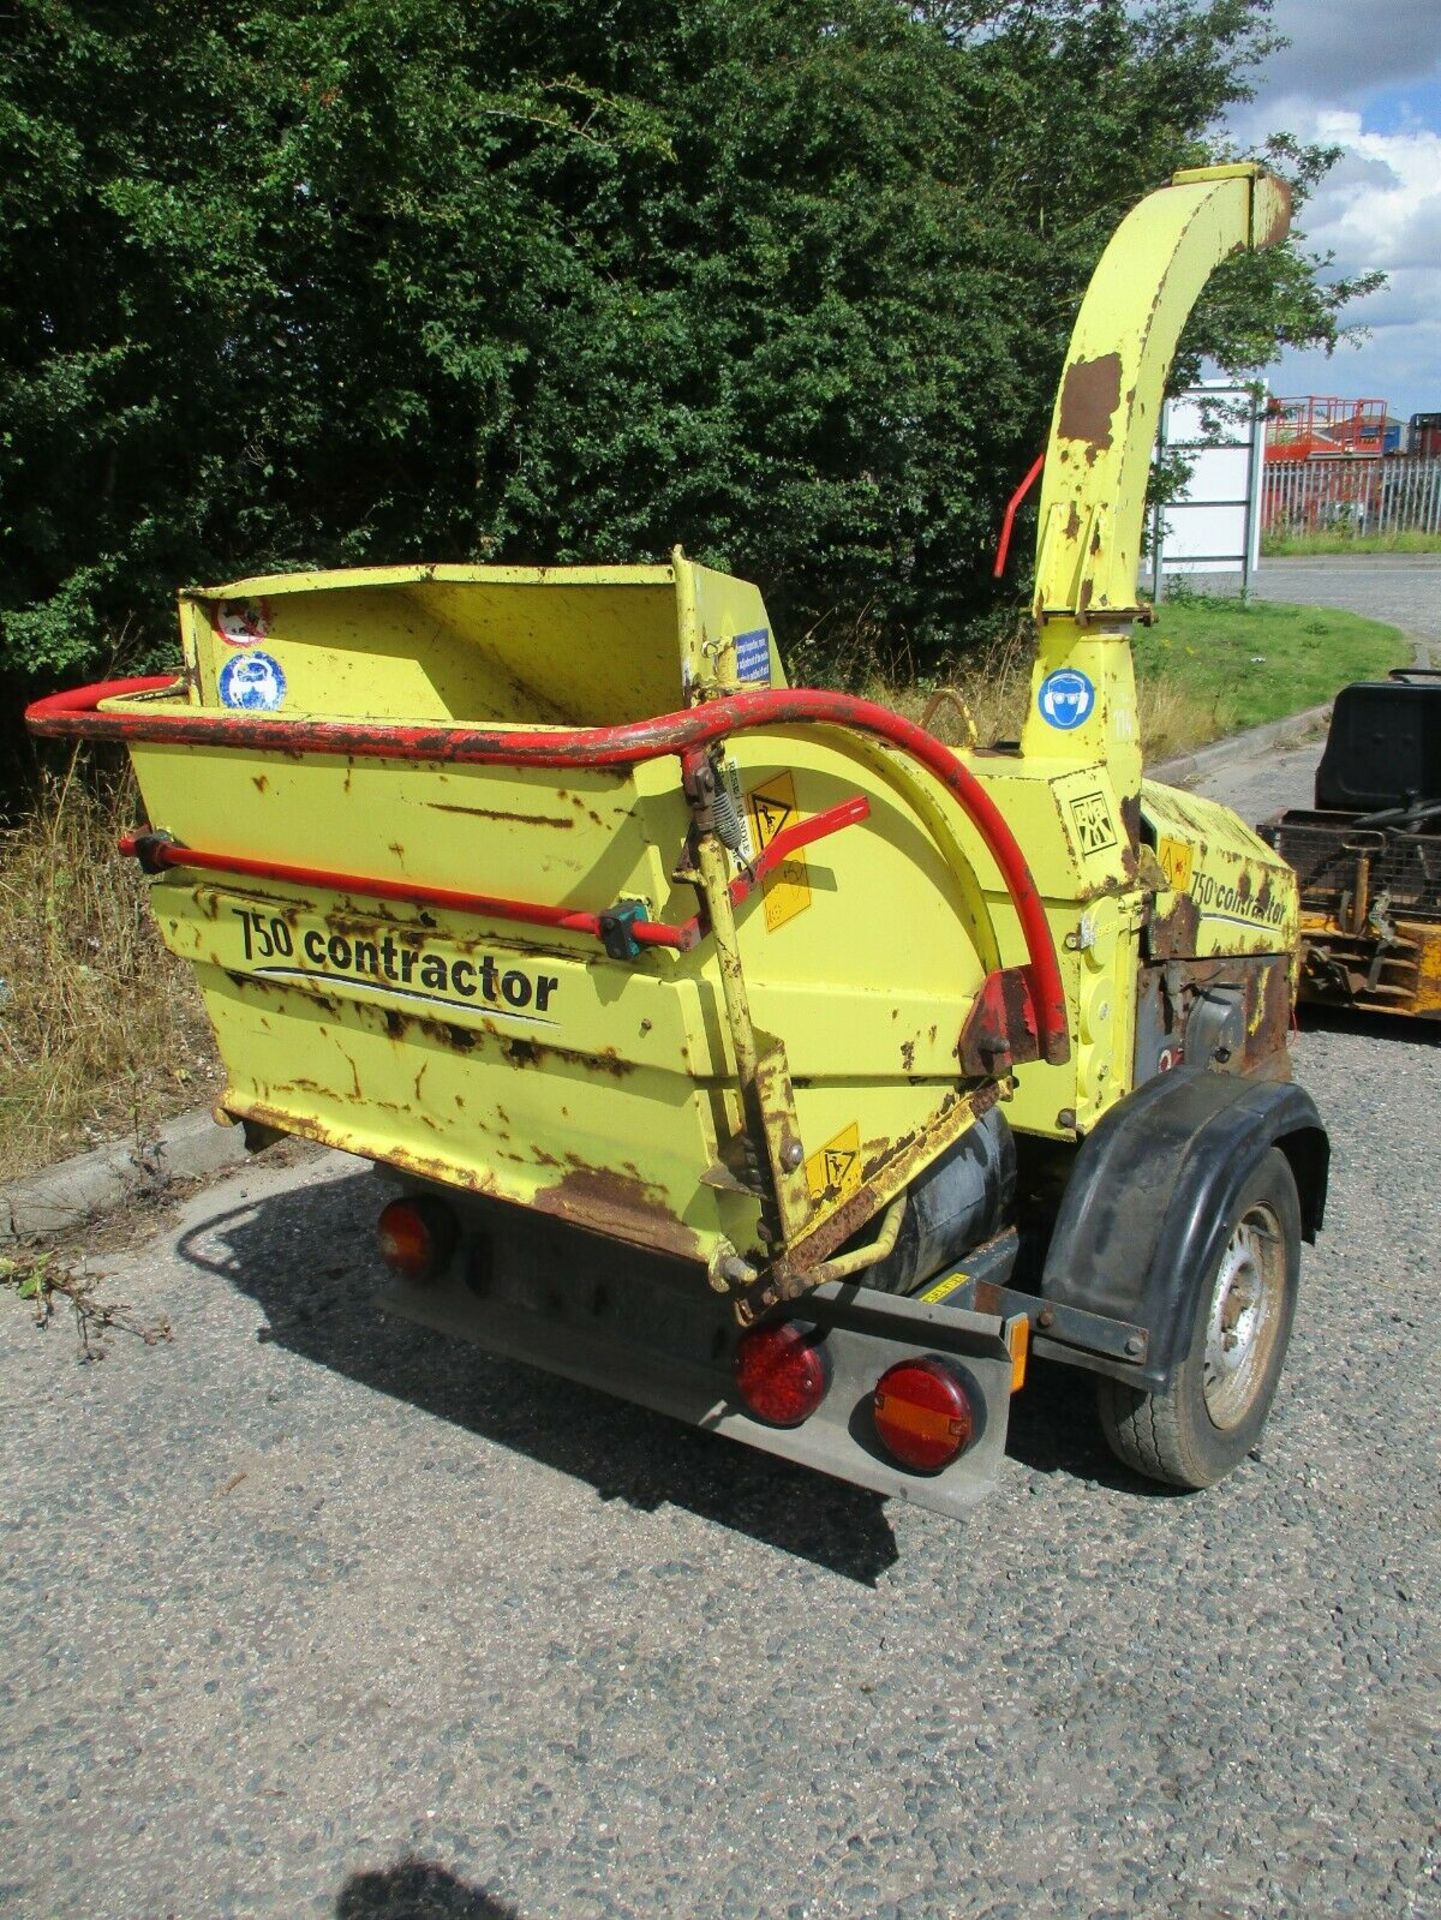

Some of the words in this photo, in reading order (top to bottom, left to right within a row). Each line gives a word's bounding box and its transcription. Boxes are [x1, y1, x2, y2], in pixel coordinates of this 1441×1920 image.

[1191, 870, 1214, 905] 750
[1215, 884, 1287, 925] conrator
[231, 908, 294, 960] 750
[303, 930, 559, 1012] contractor
